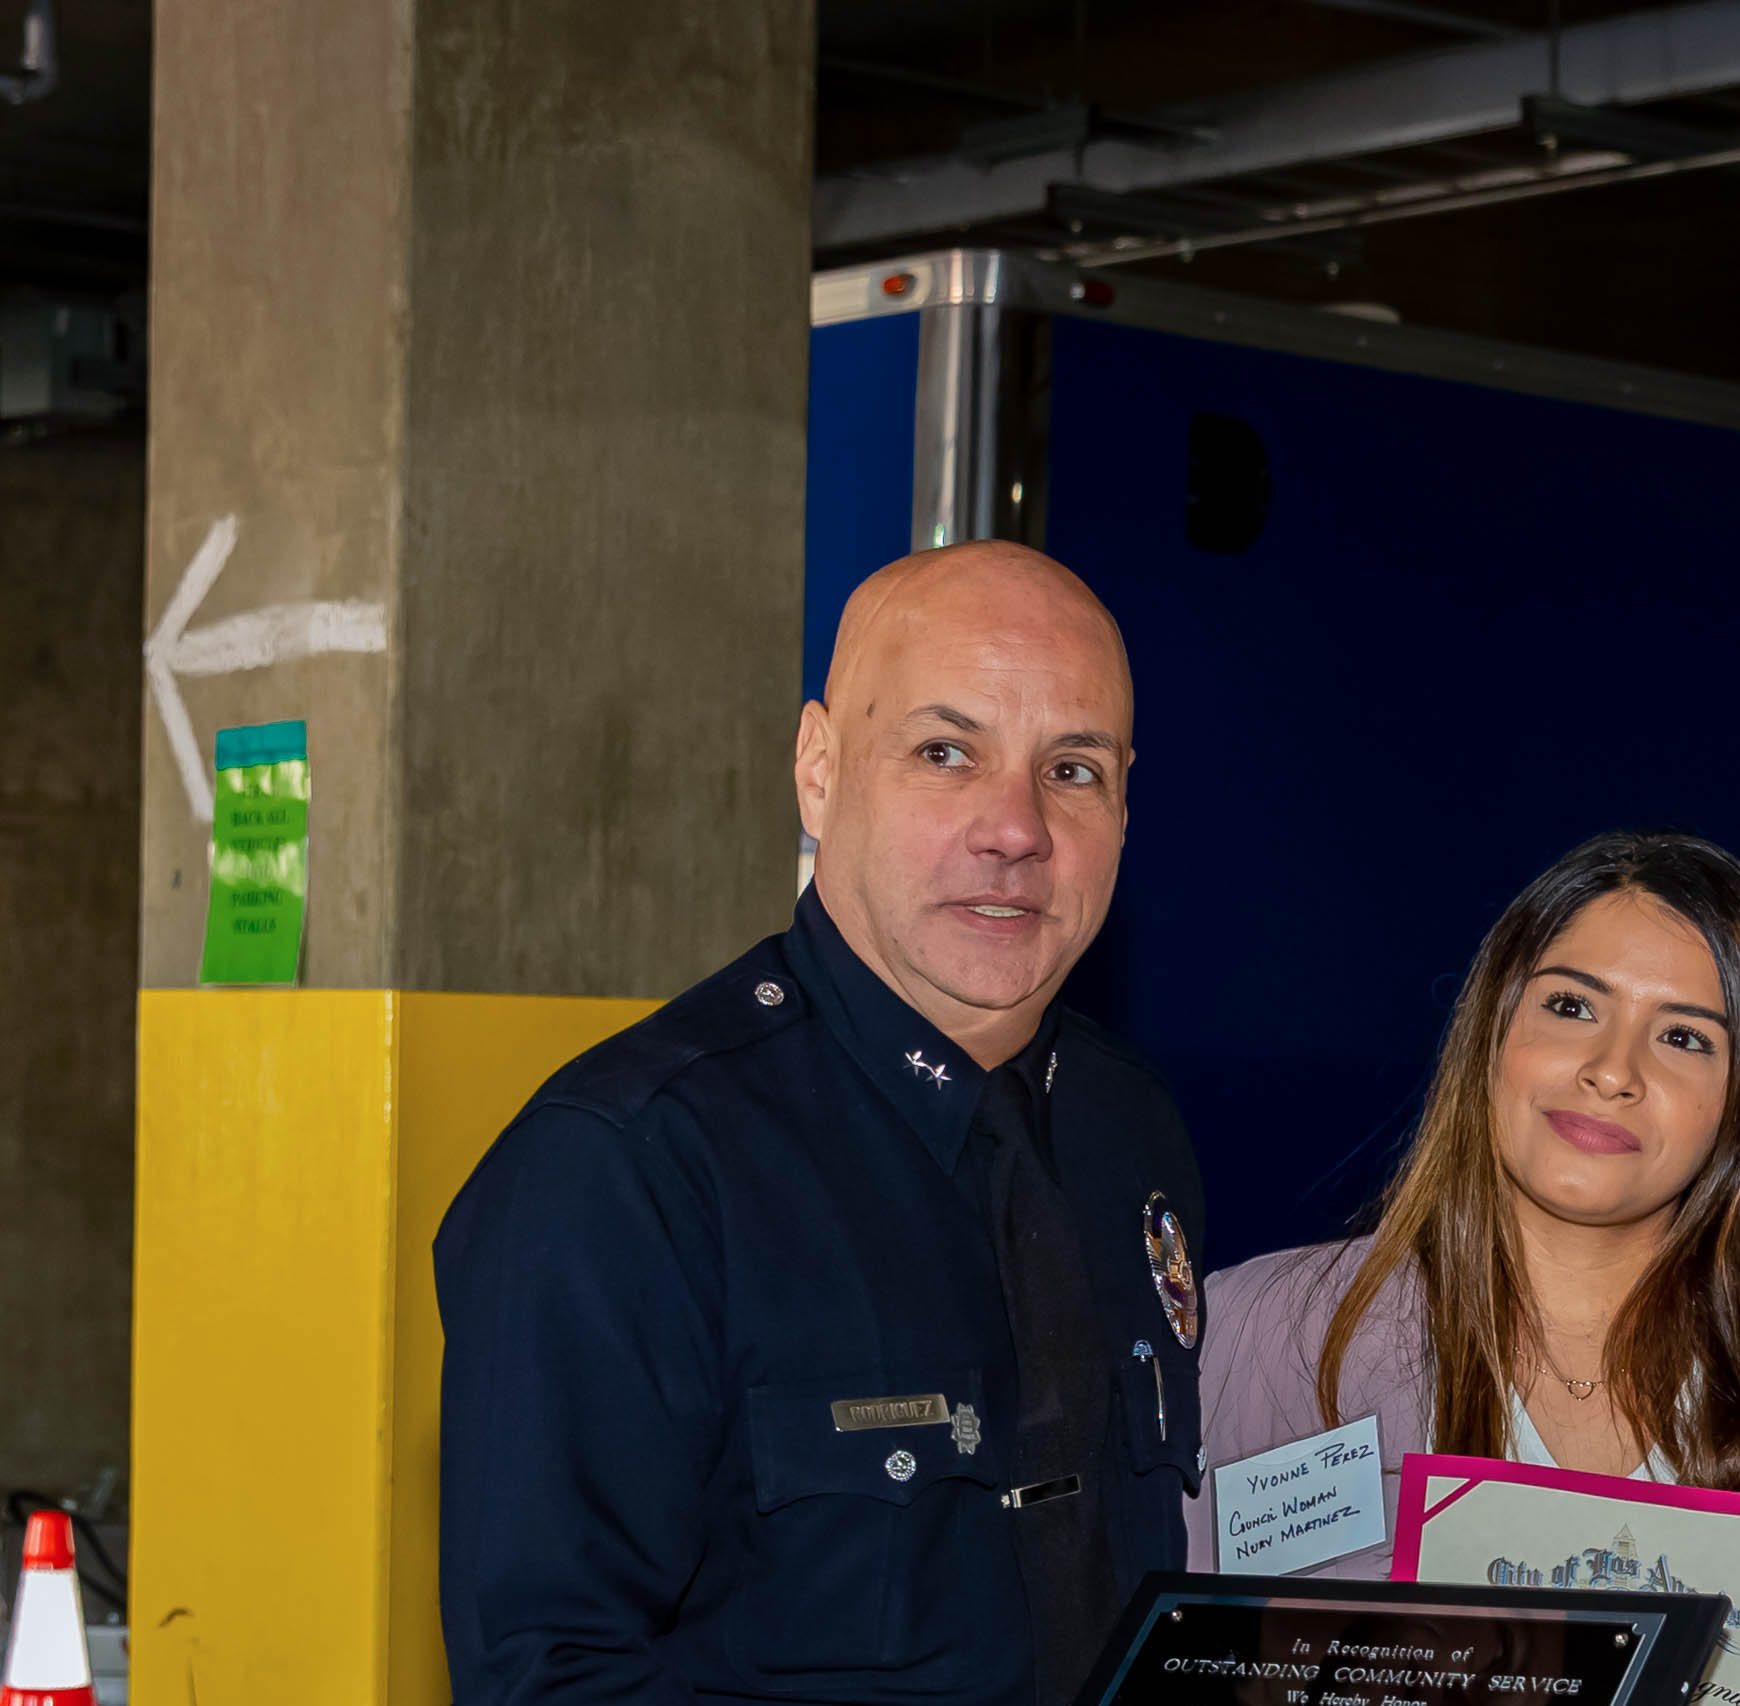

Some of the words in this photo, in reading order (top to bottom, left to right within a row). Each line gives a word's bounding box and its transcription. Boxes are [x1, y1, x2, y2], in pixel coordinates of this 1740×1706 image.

[1247, 1462, 1310, 1494] YVONNE
[1314, 1443, 1374, 1469] PEREZ
[1282, 1486, 1337, 1517] WOMAN
[1281, 1506, 1361, 1542] MARTINEZ
[1292, 1638, 1310, 1655] In
[1328, 1640, 1434, 1661] Recognition
[1452, 1646, 1474, 1663] of
[1163, 1657, 1320, 1680] OUTSTANDING
[1334, 1667, 1477, 1689] COMMUNITY
[1488, 1675, 1582, 1695] SERVICE
[1288, 1690, 1308, 1704] We
